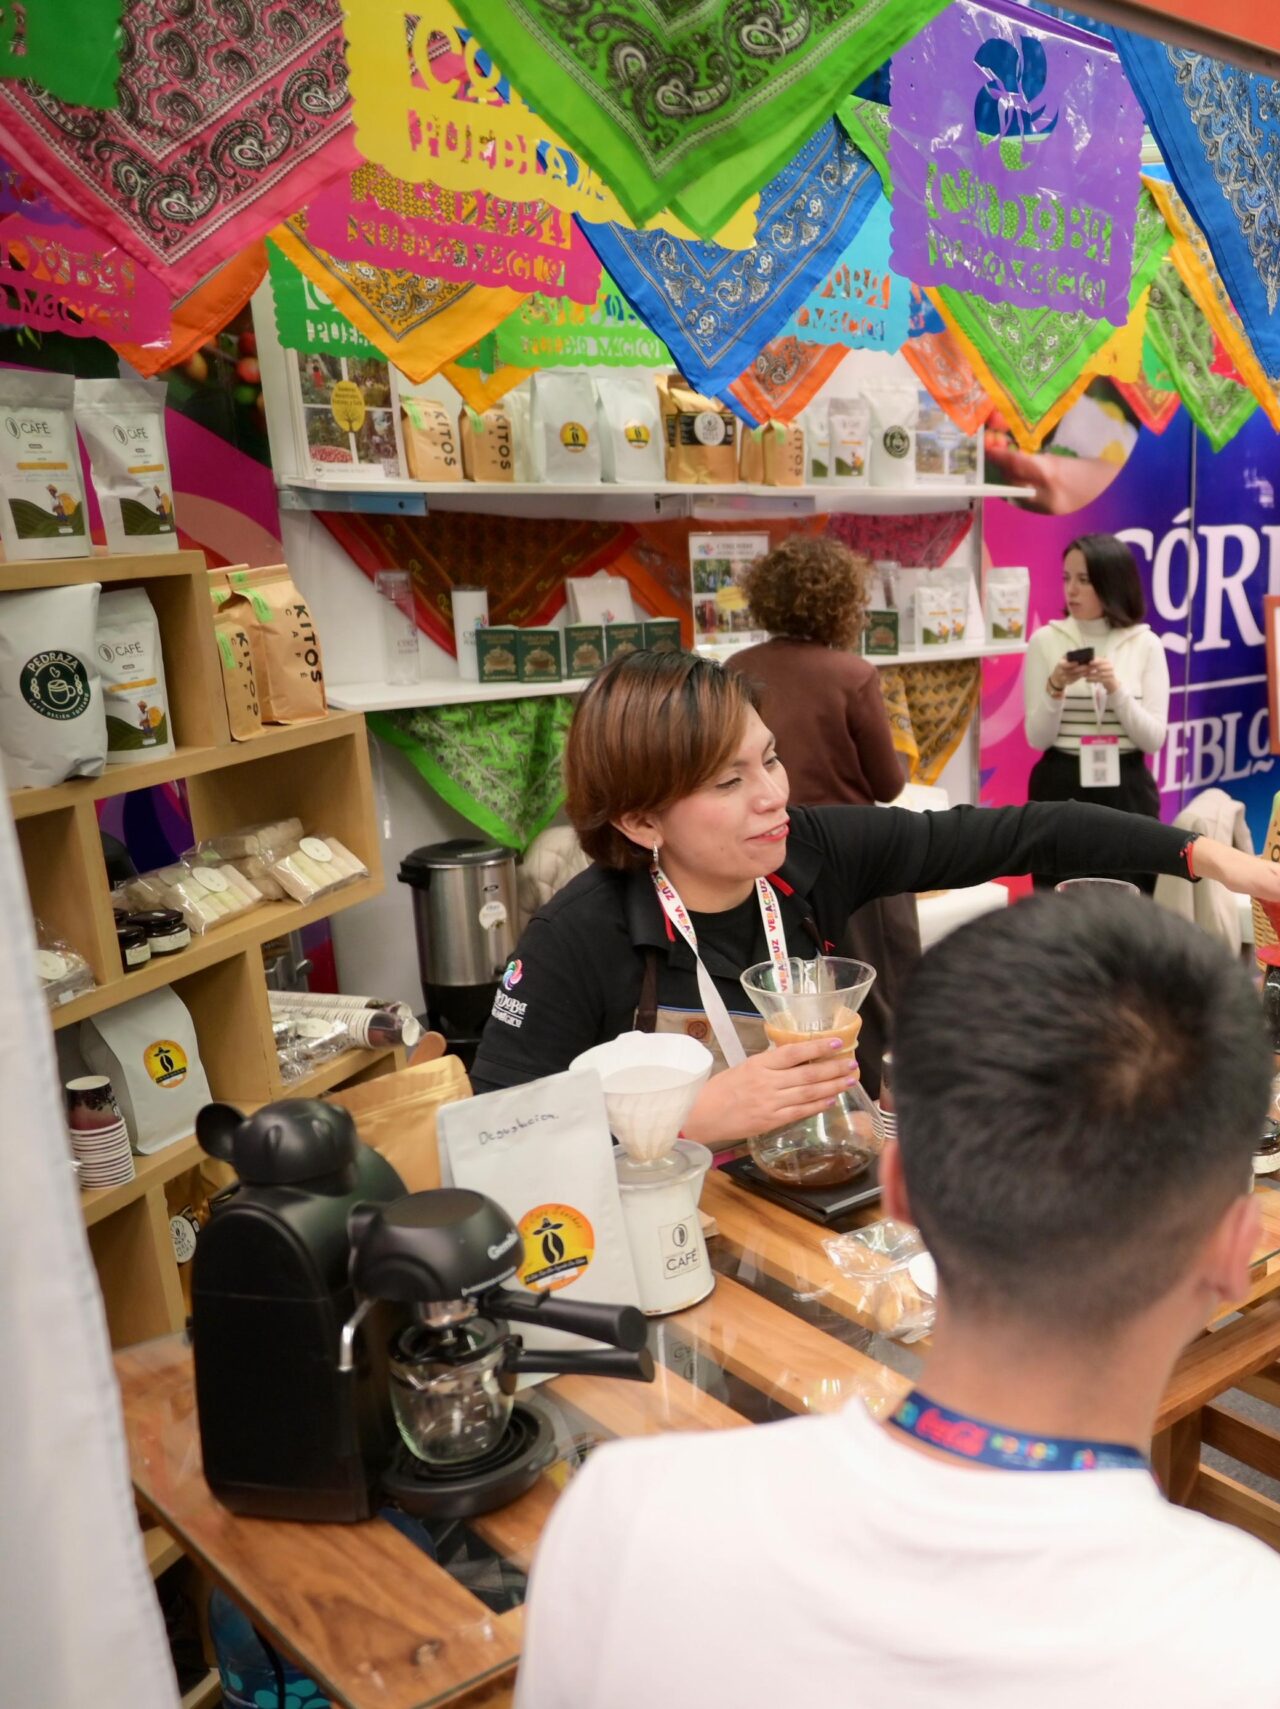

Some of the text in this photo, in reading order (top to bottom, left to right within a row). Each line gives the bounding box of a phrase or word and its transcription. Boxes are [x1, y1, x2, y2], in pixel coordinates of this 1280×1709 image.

[433, 410, 457, 467] KITOS
[494, 413, 512, 470] KITOS
[28, 652, 79, 672] PEDRAZA
[293, 604, 322, 684] KITOS
[236, 632, 259, 717] KITOS
[666, 1248, 698, 1271] CAFÉ
